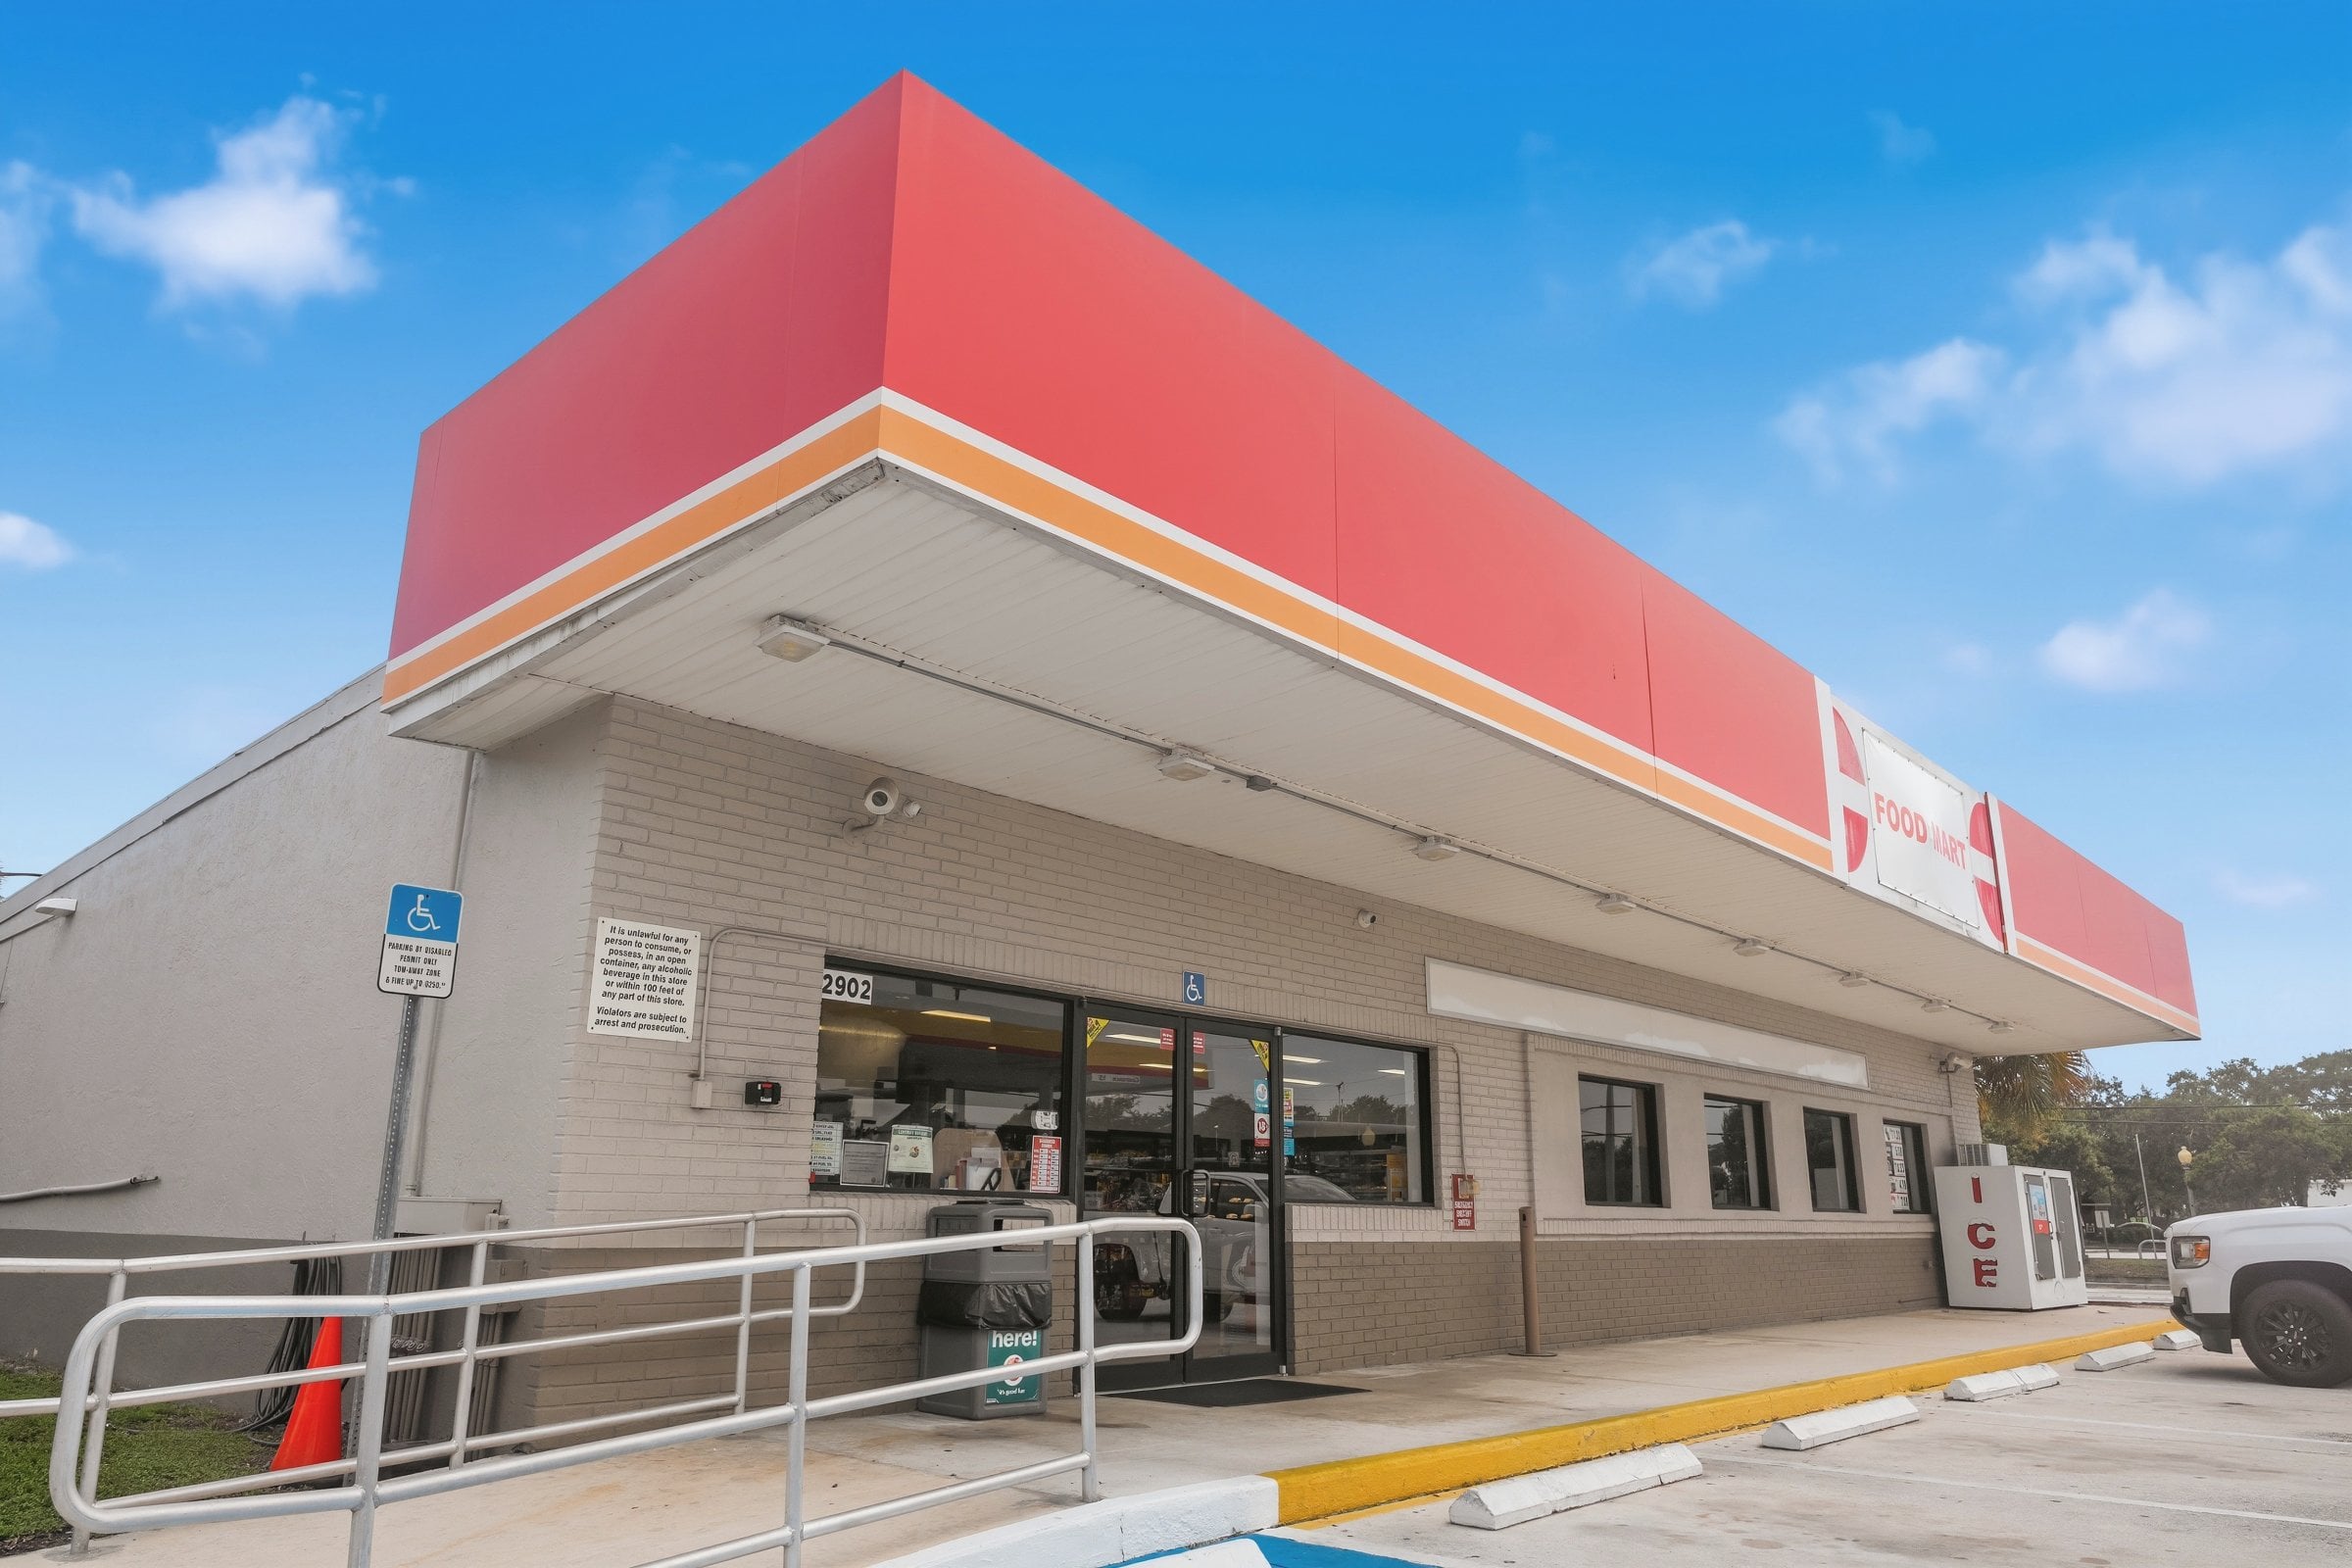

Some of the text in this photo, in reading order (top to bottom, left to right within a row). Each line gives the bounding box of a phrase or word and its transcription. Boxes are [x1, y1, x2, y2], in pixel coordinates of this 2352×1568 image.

[1874, 792, 1966, 870] FOOD MART
[627, 929, 661, 941] unlawful
[662, 933, 673, 943] for
[675, 937, 689, 946] any
[388, 943, 414, 953] PARKING
[605, 937, 633, 947] person
[645, 943, 681, 956] consume,
[400, 955, 421, 964] PERMIT
[609, 949, 644, 960] possess,
[646, 952, 654, 960] in
[667, 956, 686, 965] open
[600, 957, 693, 976] container, any alcoholic
[604, 968, 688, 986] beverage in this store
[616, 980, 641, 991] within
[644, 984, 658, 993] 100
[660, 986, 674, 995] feet
[822, 973, 871, 1000] 2902
[602, 991, 616, 1001] any
[647, 995, 662, 1004] this
[663, 998, 685, 1006] store.
[597, 1006, 632, 1018] Violators
[649, 1012, 677, 1023] subject
[595, 1018, 686, 1034] arrest and prosecution.
[1967, 1173, 1998, 1288] ICE
[992, 1331, 1038, 1348] here!
